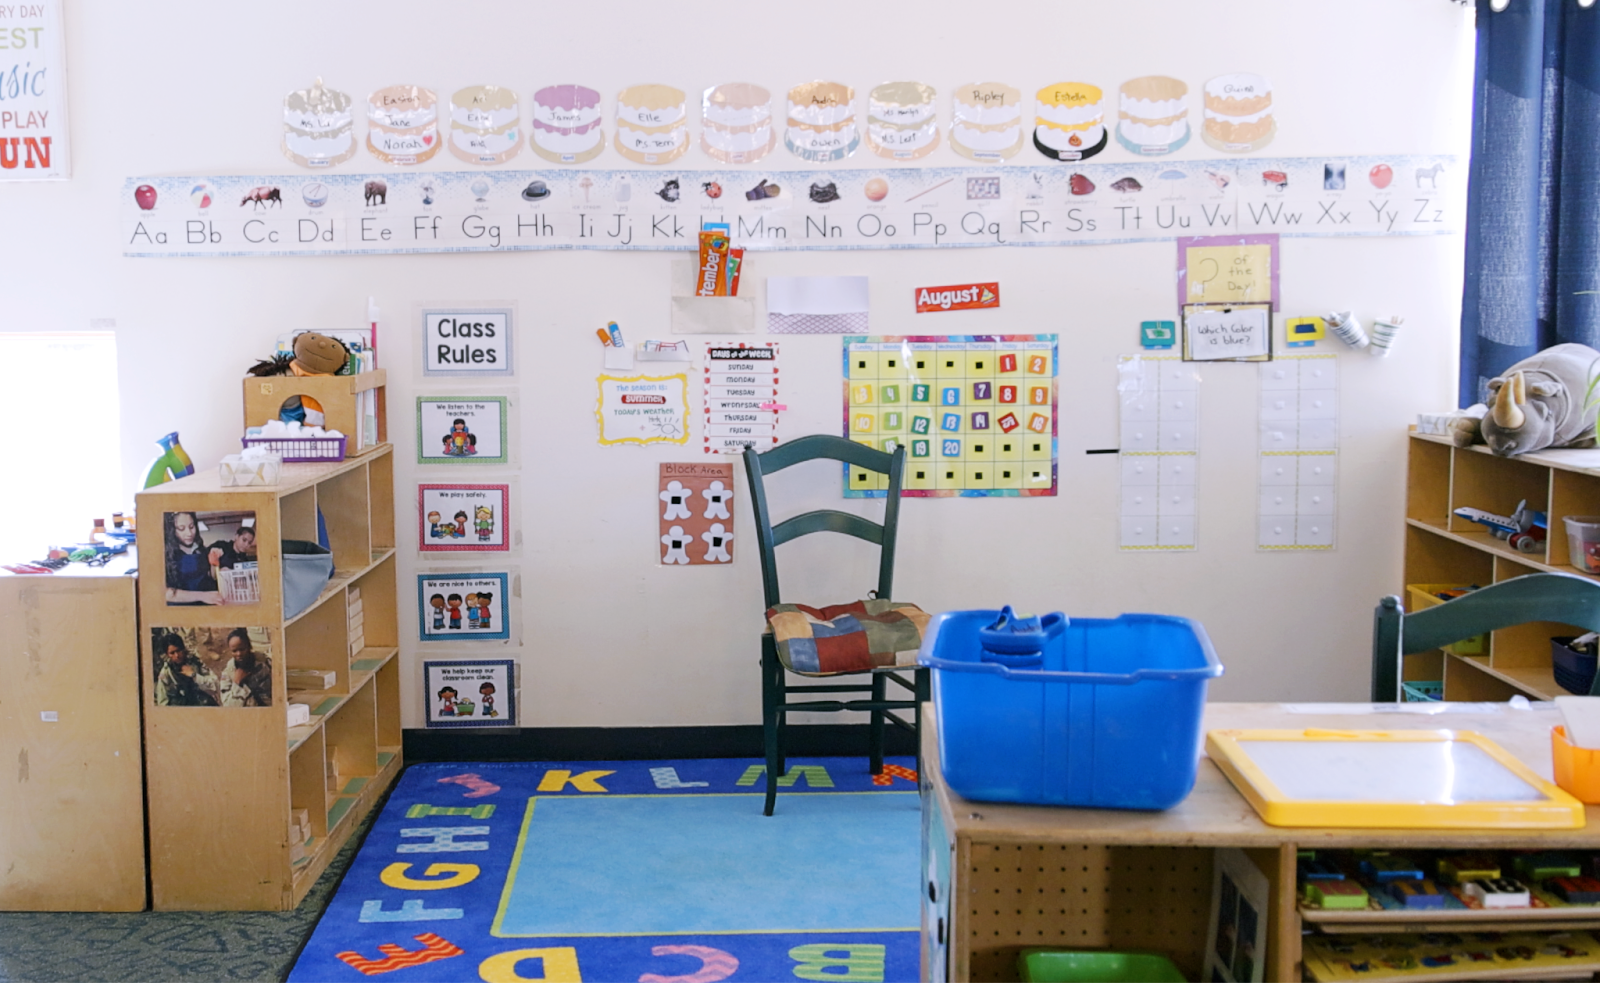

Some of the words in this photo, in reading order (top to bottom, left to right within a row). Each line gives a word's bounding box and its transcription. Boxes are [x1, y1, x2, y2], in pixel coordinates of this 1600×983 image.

[20, 5, 45, 18] DAY
[972, 90, 1005, 106] Ripley
[2, 110, 49, 129] PLAY
[384, 114, 411, 127] Jane
[547, 111, 581, 121] James
[638, 113, 662, 122] Elle
[383, 138, 423, 150] Norah
[0, 136, 52, 169] UN
[363, 207, 388, 215] elephant
[130, 221, 168, 244] Aa
[186, 220, 222, 243] Bb
[243, 219, 279, 243] Cc
[298, 218, 334, 242] Dd
[361, 217, 392, 241] Ee
[414, 216, 443, 240] Ff
[462, 214, 501, 248] Gg
[517, 213, 554, 237] Hh
[579, 213, 594, 237] Ii
[606, 214, 633, 245] Jj
[652, 213, 685, 237] Kk
[738, 214, 787, 239] Mm
[805, 214, 842, 238] Nn
[857, 213, 897, 237] Oo
[913, 212, 947, 244] Pp
[961, 211, 1006, 243] Qq
[1020, 210, 1052, 233] Rr
[1066, 208, 1097, 232] Ss
[1113, 206, 1143, 230] Tt
[1156, 204, 1190, 228] Uu
[1201, 203, 1231, 226] Vv
[1248, 202, 1303, 225] Ww
[1316, 201, 1351, 224] Xx
[1369, 200, 1399, 232] Yy
[1413, 199, 1444, 222] Zz
[698, 248, 721, 296] tember
[1227, 266, 1253, 276] the
[1227, 280, 1257, 297] Day!
[917, 286, 980, 309] August
[437, 318, 496, 338] Class
[1197, 324, 1229, 335] Which
[911, 343, 932, 351] Tuesday
[937, 342, 966, 350] Wednesday
[969, 342, 993, 351] Thursday
[1001, 342, 1018, 350] Friday
[1026, 342, 1050, 350] Saturday
[1210, 335, 1218, 345] is
[1223, 335, 1251, 345] blue?
[437, 344, 497, 364] Rules
[712, 350, 731, 359] DAYS
[749, 350, 772, 359] WEEK
[728, 363, 754, 371] SUNDAY
[1005, 357, 1011, 370] 1
[1033, 358, 1042, 371] 2
[726, 376, 756, 384] MONDAY
[616, 384, 629, 392] The
[859, 387, 868, 400] 3
[887, 387, 895, 400] 4
[916, 386, 925, 400] 5
[947, 390, 955, 403] 6
[978, 384, 987, 398] 7
[1003, 387, 1012, 401] 8
[1035, 388, 1043, 401] 9
[723, 414, 757, 422] THURSDAY
[858, 417, 870, 429] 10
[889, 414, 898, 427] 11
[914, 418, 927, 432] 12
[945, 415, 957, 429] 13
[975, 413, 986, 428] 14
[1001, 415, 1016, 429] 15
[1032, 417, 1044, 431] 16
[915, 441, 927, 455] 19
[944, 441, 959, 455] 20
[666, 463, 697, 474] Block
[700, 466, 724, 475] Area
[450, 491, 465, 499] play
[466, 491, 487, 499] safely.
[452, 668, 466, 676] help
[466, 668, 483, 676] keep
[536, 769, 616, 793] K
[649, 767, 709, 790] L
[396, 825, 491, 853] H
[380, 861, 481, 891] G
[358, 899, 465, 924] F
[335, 932, 465, 976] E
[478, 946, 583, 983] D
[637, 944, 740, 983] C
[788, 943, 886, 983] B
